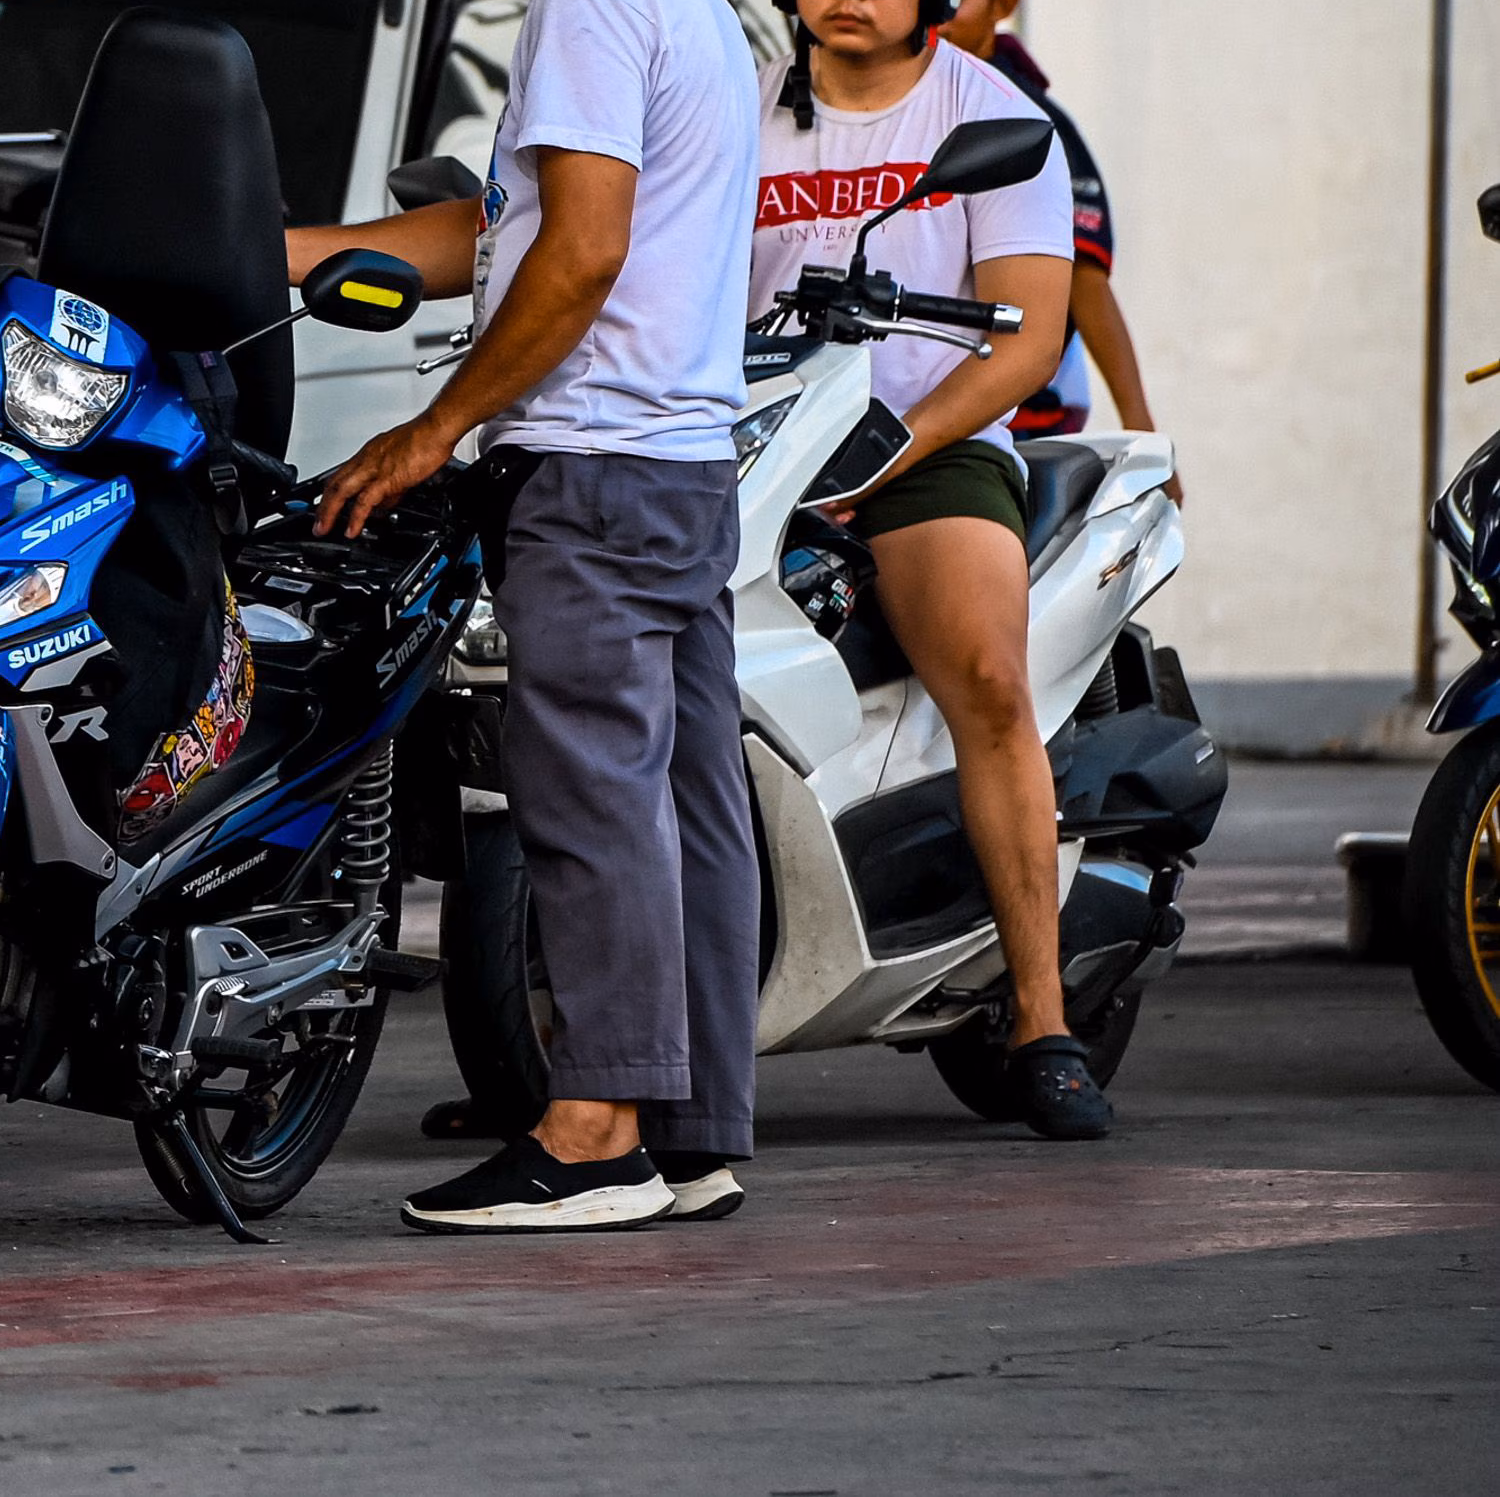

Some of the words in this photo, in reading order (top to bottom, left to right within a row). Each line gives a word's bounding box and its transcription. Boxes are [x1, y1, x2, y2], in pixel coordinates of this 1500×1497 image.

[758, 179, 821, 219] AN
[19, 481, 127, 554] Smash
[8, 624, 91, 669] SUZUKI
[375, 609, 438, 689] Smash
[181, 864, 223, 896] SPORT
[195, 849, 269, 898] UNDERBONE
